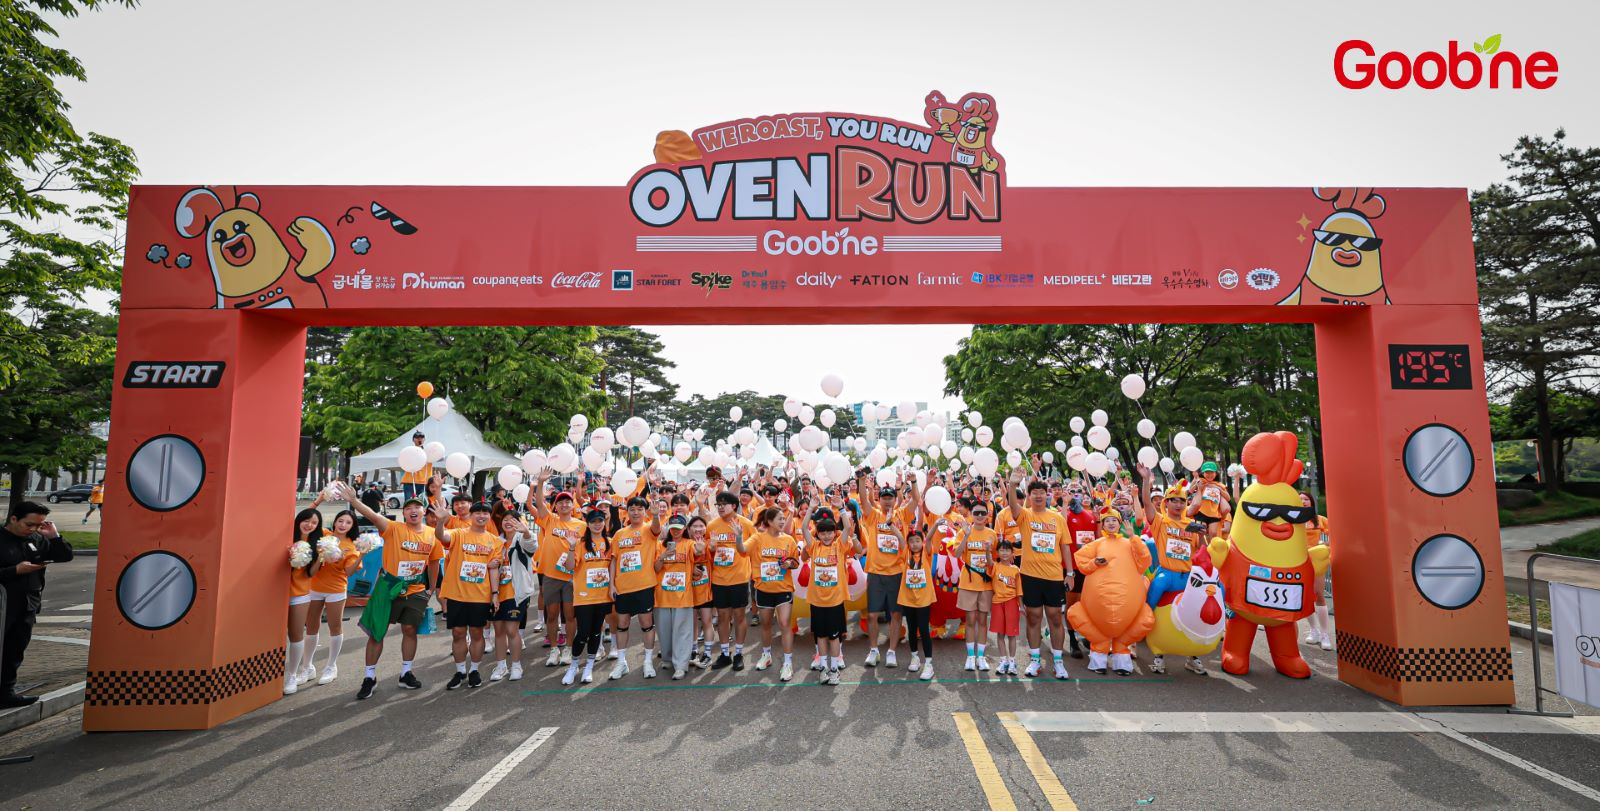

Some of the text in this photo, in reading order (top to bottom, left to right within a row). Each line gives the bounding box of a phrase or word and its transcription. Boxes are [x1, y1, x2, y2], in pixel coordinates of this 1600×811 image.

[697, 117, 934, 154] WE ROAST, YOU RUN
[630, 145, 1001, 228] OVEN RUN
[332, 271, 374, 290] 굽네몰
[472, 275, 519, 288] coupang
[519, 274, 543, 285] eats
[690, 271, 733, 290] Spike
[917, 272, 963, 286] farmic
[1111, 274, 1153, 286] 비타그란
[130, 364, 219, 384] START
